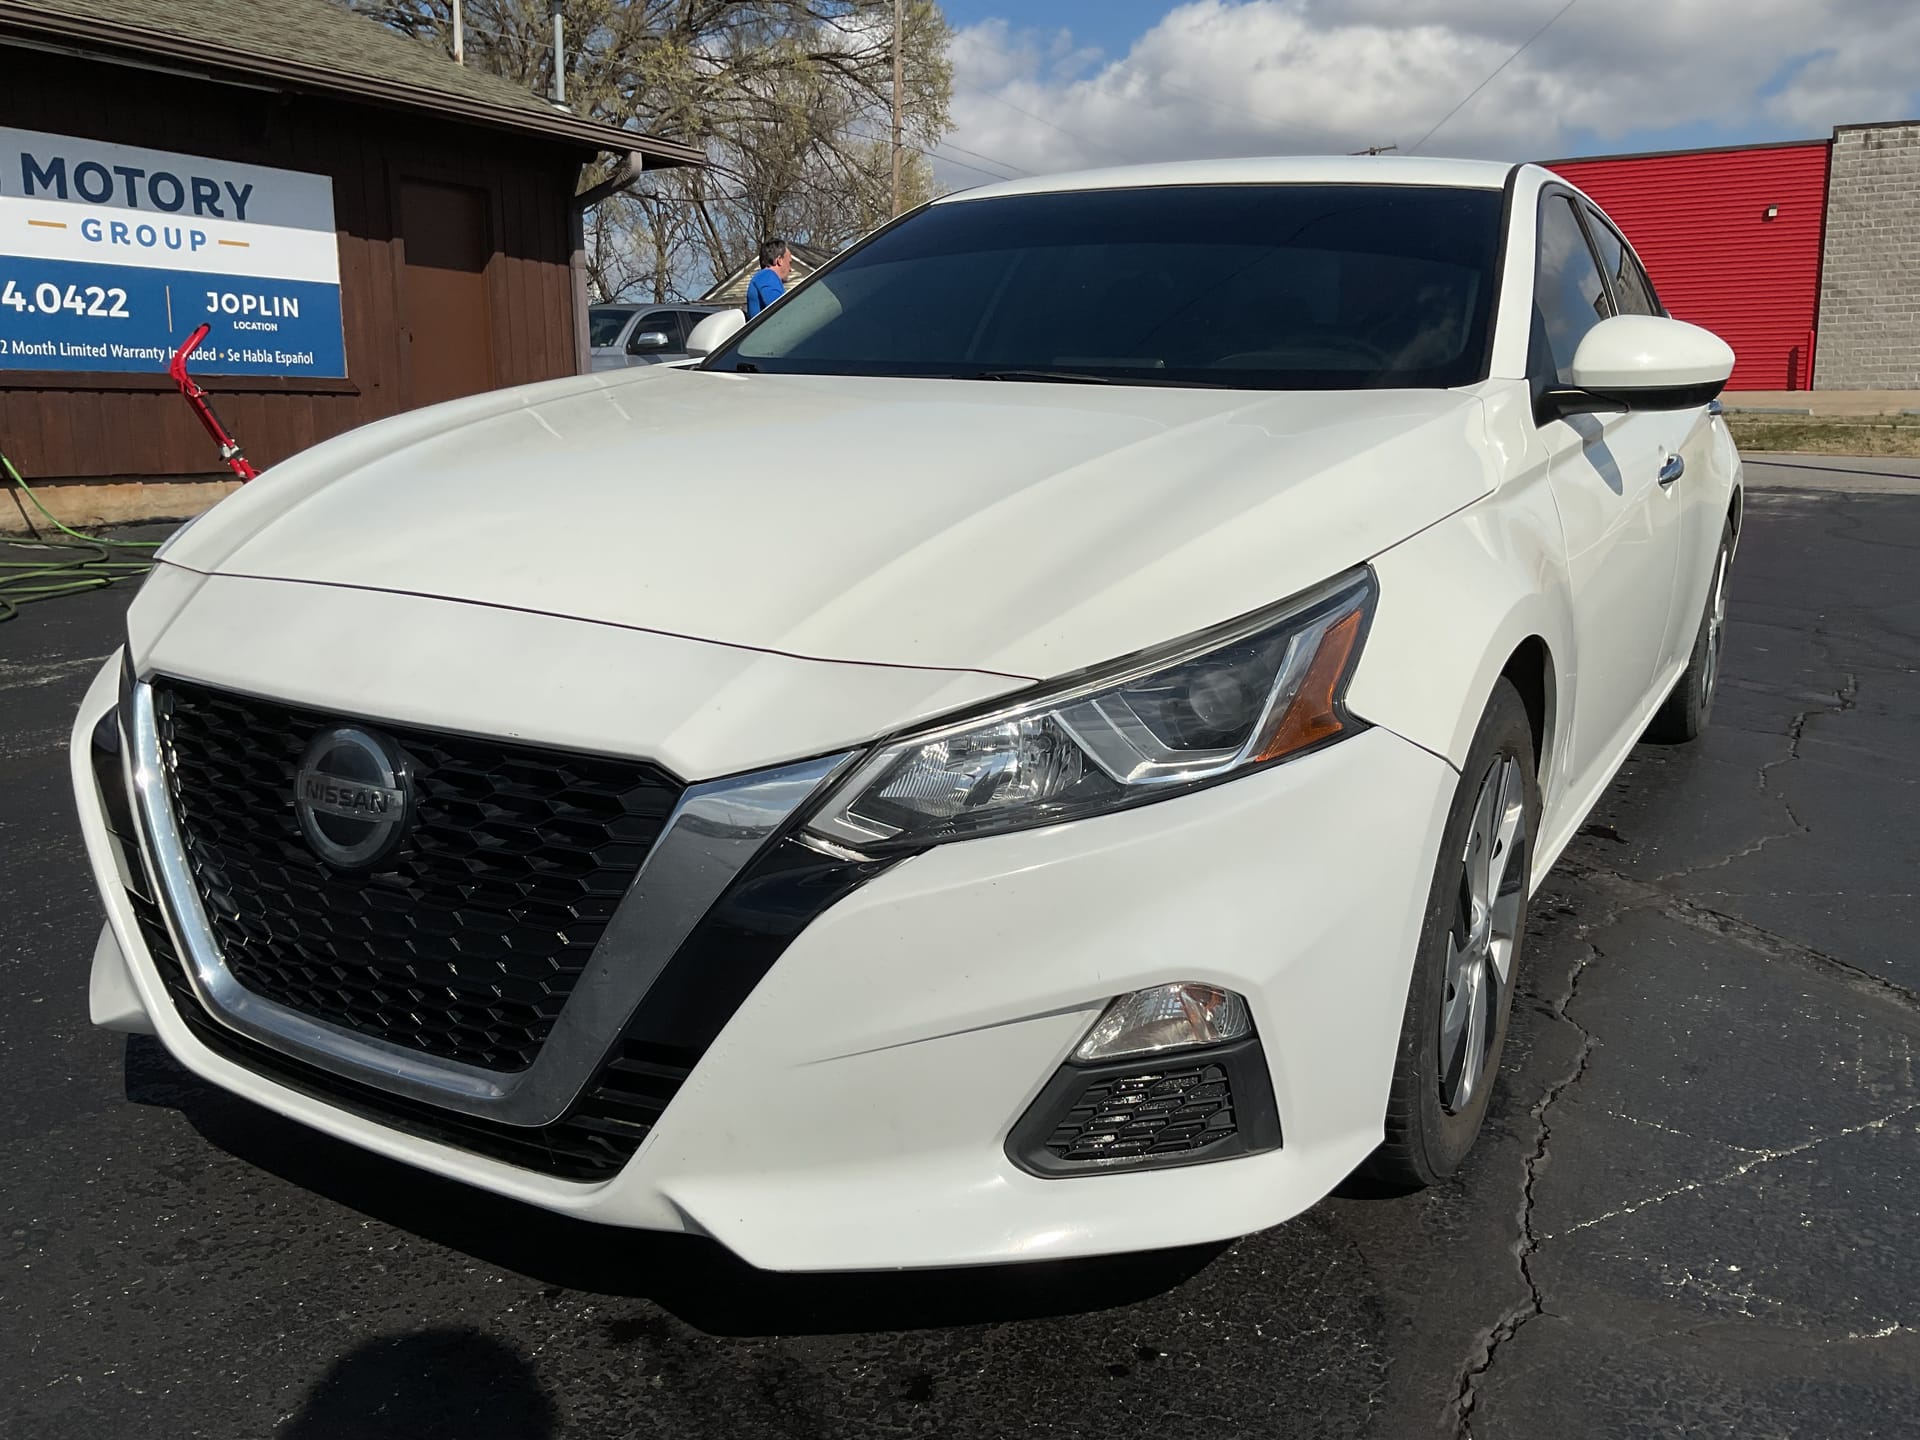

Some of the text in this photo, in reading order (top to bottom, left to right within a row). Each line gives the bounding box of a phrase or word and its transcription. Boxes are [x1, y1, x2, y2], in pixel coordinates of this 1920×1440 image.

[21, 152, 253, 220] MOTORY
[81, 218, 207, 252] GROUP
[2, 280, 130, 318] 4.0422
[206, 291, 299, 318] JOPLIN
[233, 320, 278, 332] LOCATION
[12, 340, 57, 356] Month
[60, 342, 107, 358] Limited
[110, 344, 165, 363] Warranty
[227, 348, 240, 362] Se
[243, 349, 273, 363] Habla
[275, 351, 313, 367] Español
[305, 780, 388, 813] NISSAN
